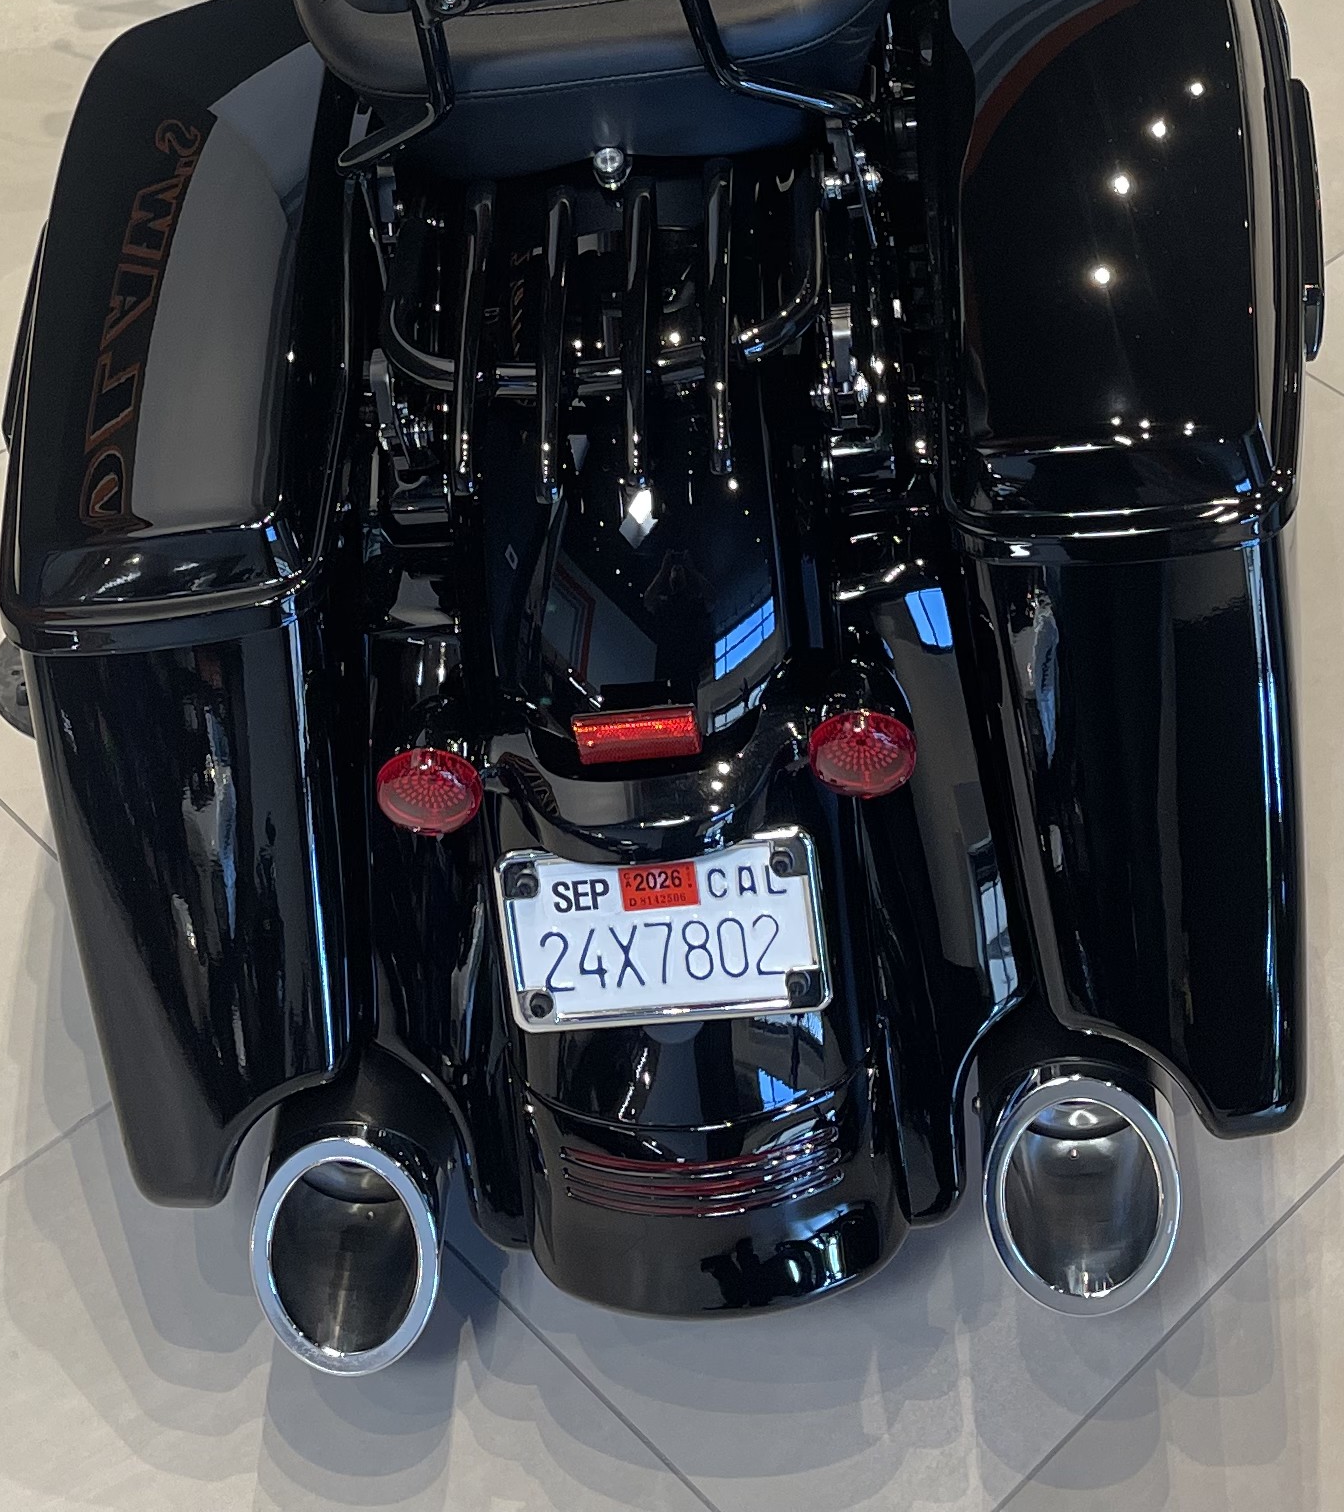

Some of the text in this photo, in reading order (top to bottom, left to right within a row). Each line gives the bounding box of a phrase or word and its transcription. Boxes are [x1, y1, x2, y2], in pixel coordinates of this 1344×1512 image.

[551, 879, 610, 913] SEP
[633, 869, 682, 892] 2026
[540, 914, 786, 992] 24X7802
